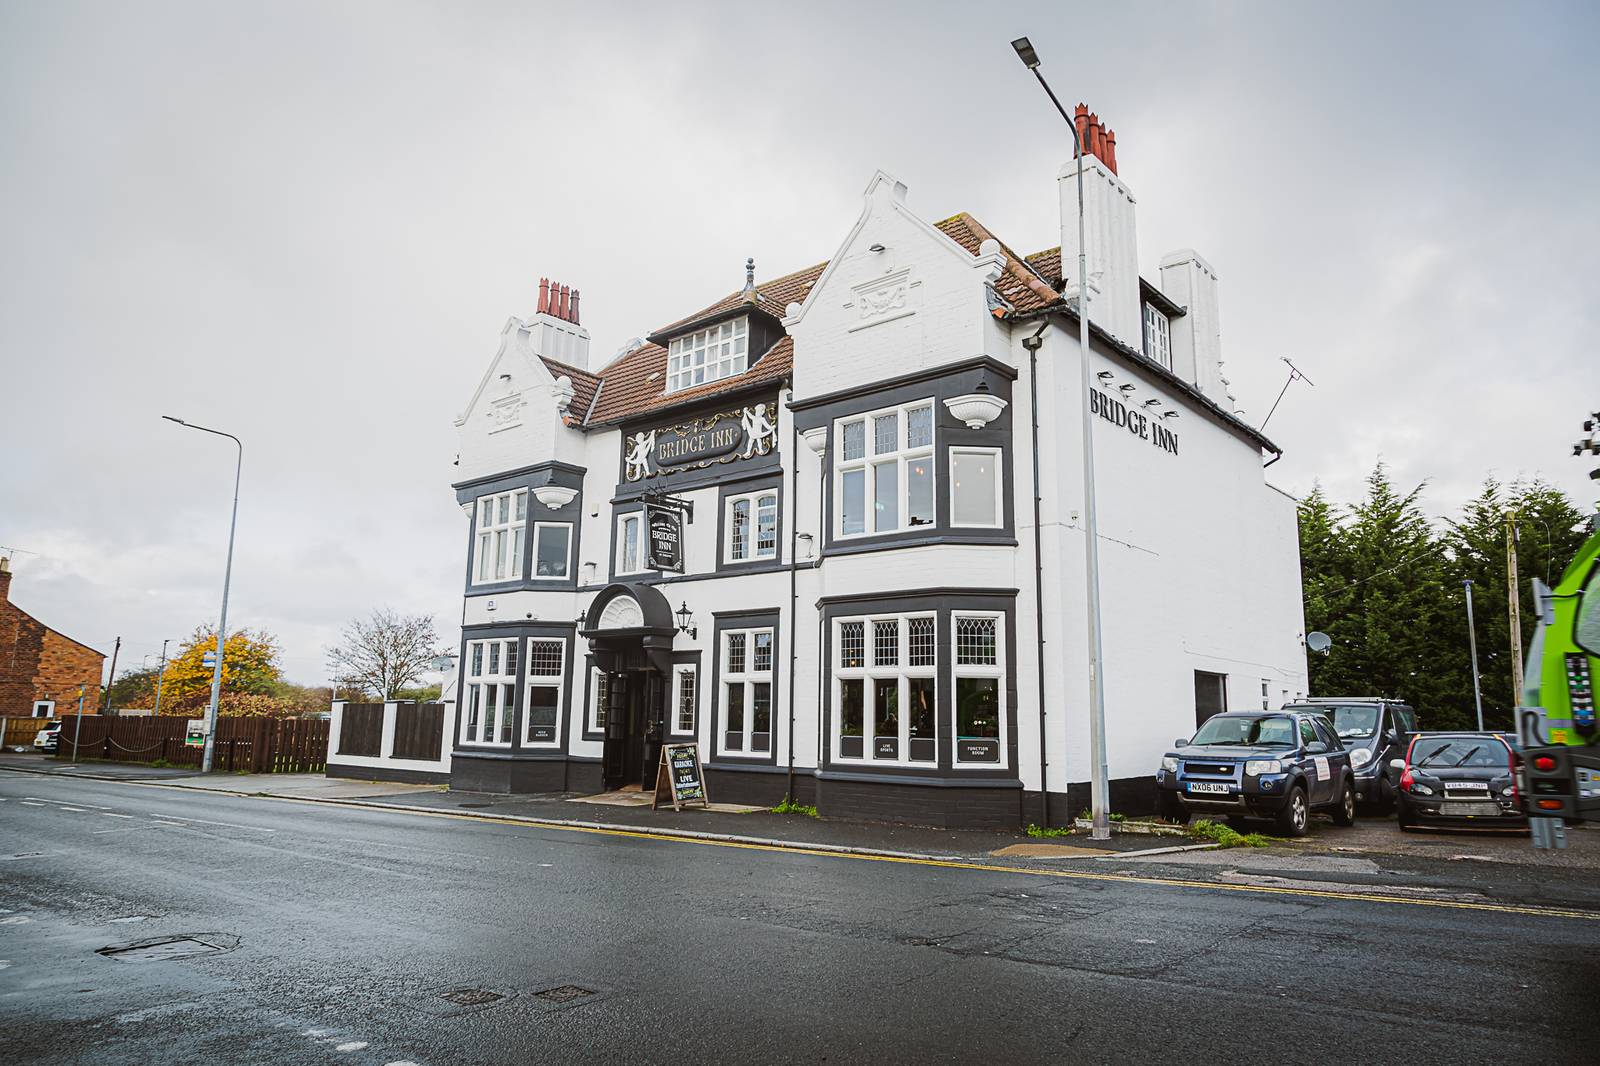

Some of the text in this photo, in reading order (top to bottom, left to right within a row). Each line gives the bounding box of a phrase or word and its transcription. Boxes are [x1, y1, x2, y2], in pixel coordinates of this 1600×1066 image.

[1089, 386, 1179, 456] BRIDGE INN
[659, 428, 734, 460] BRIDGE INN
[651, 529, 678, 543] BRIDGE
[658, 540, 672, 551] INN
[680, 774, 693, 783] LIVE
